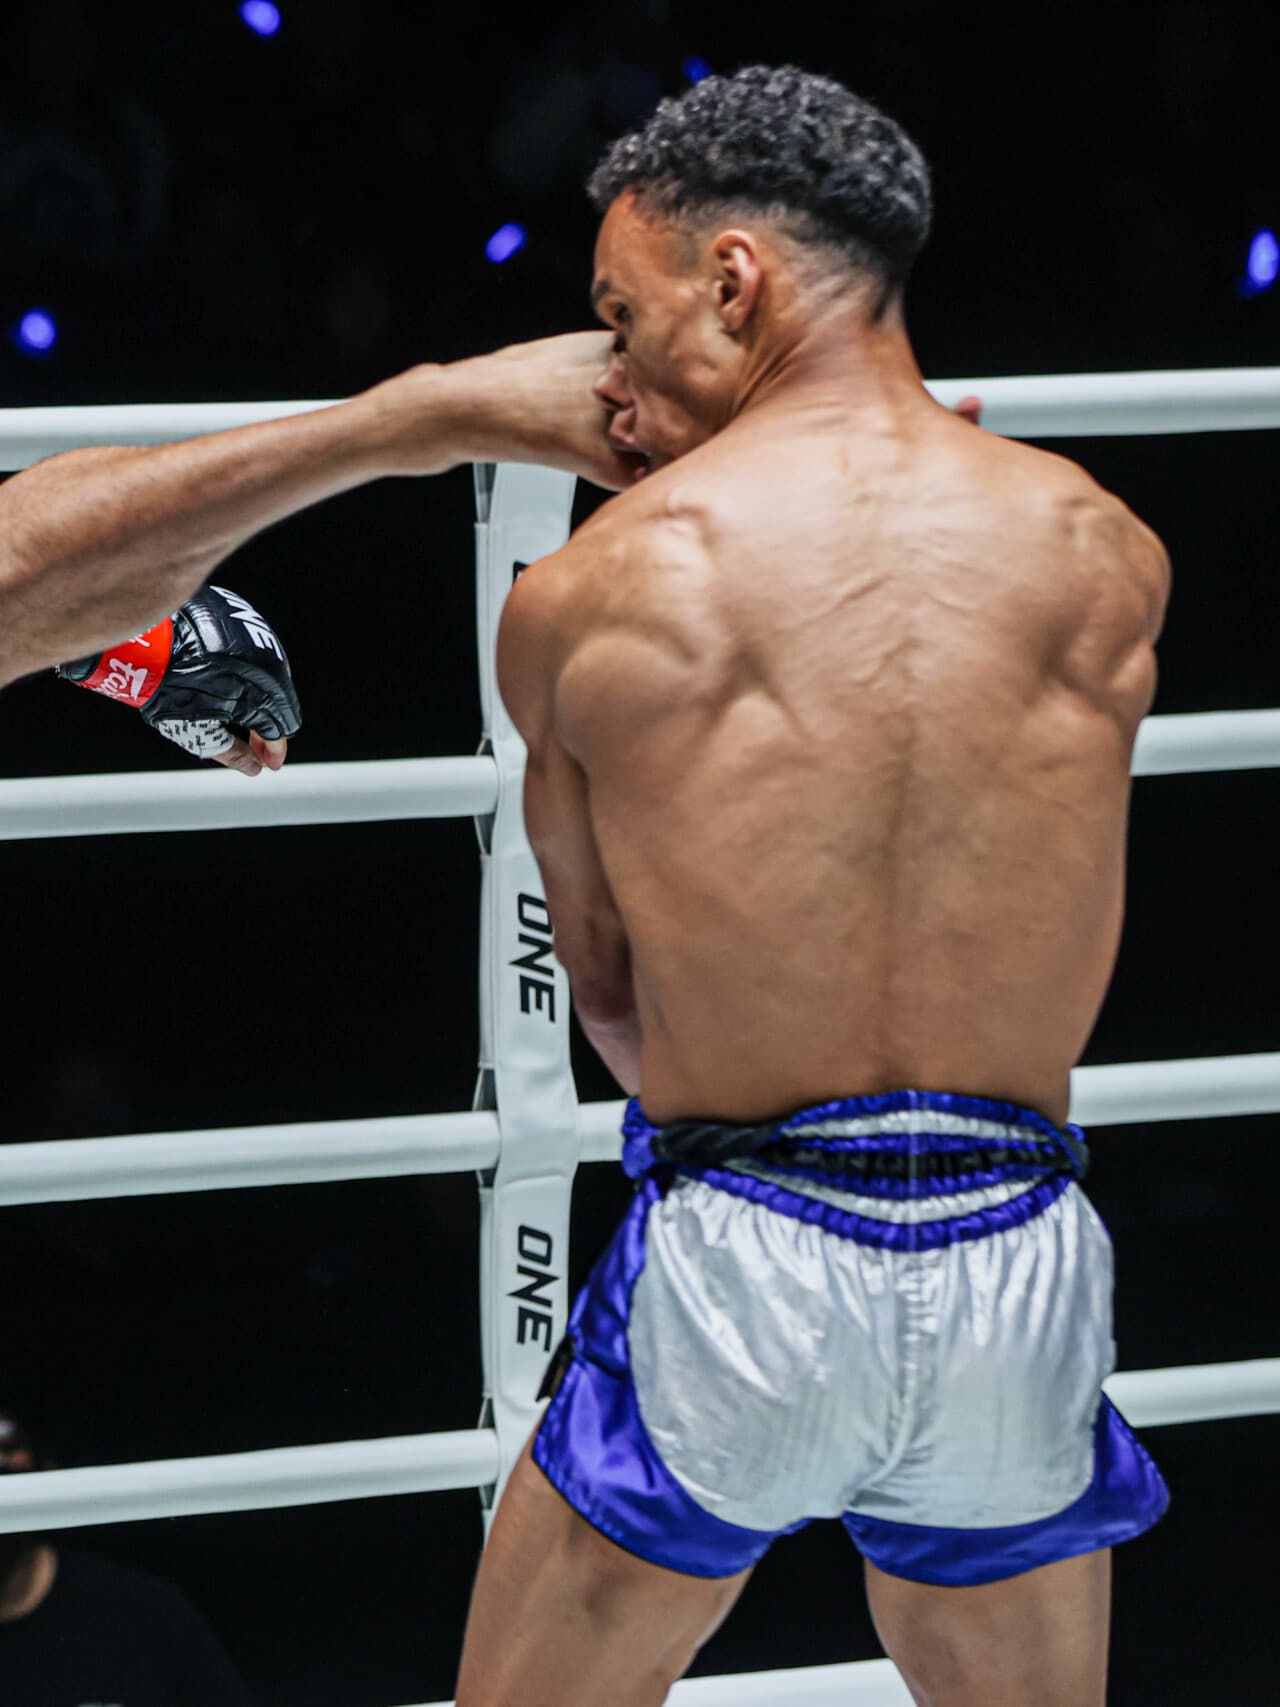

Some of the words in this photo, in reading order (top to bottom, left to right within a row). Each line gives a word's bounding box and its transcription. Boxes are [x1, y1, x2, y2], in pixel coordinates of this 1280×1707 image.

[210, 585, 284, 662] ONE
[508, 892, 556, 1023] ONE
[506, 1224, 560, 1352] ONE
